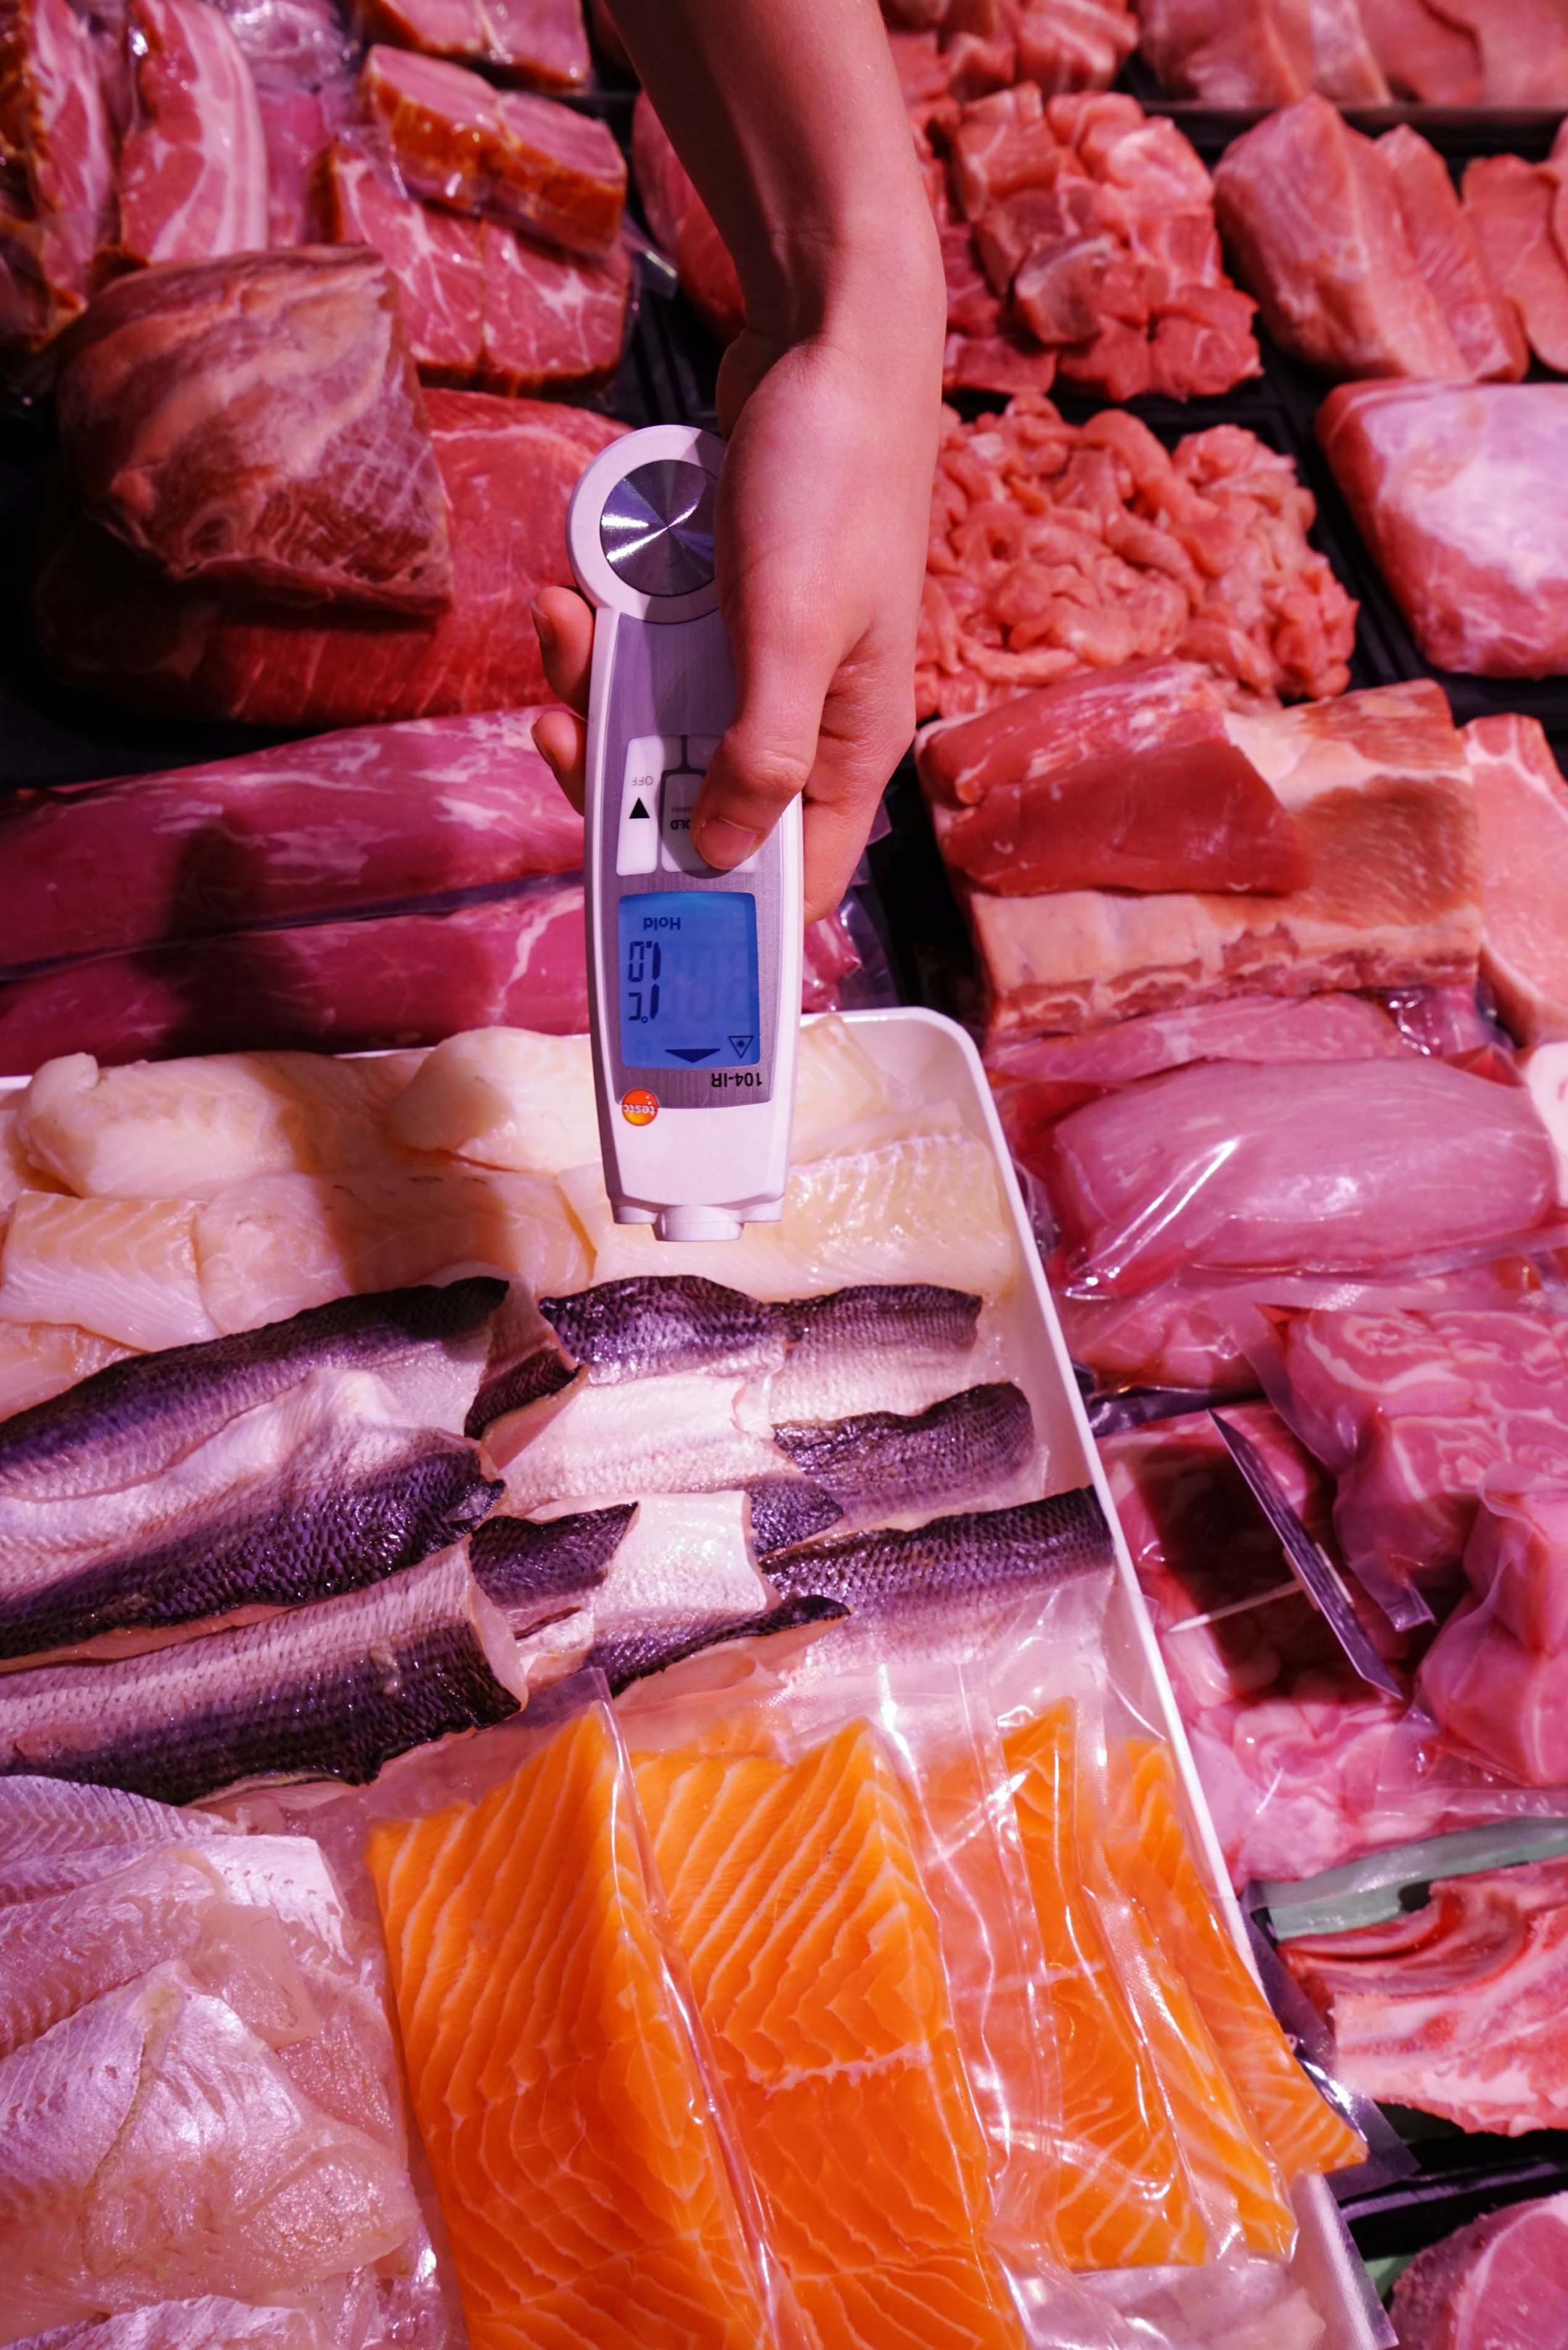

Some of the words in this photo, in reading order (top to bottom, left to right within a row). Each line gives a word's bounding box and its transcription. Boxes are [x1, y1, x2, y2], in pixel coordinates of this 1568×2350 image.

[631, 775, 653, 786] OFF
[643, 917, 681, 931] Hold
[628, 940, 661, 982] 1.0
[711, 1072, 762, 1088] 104-IR
